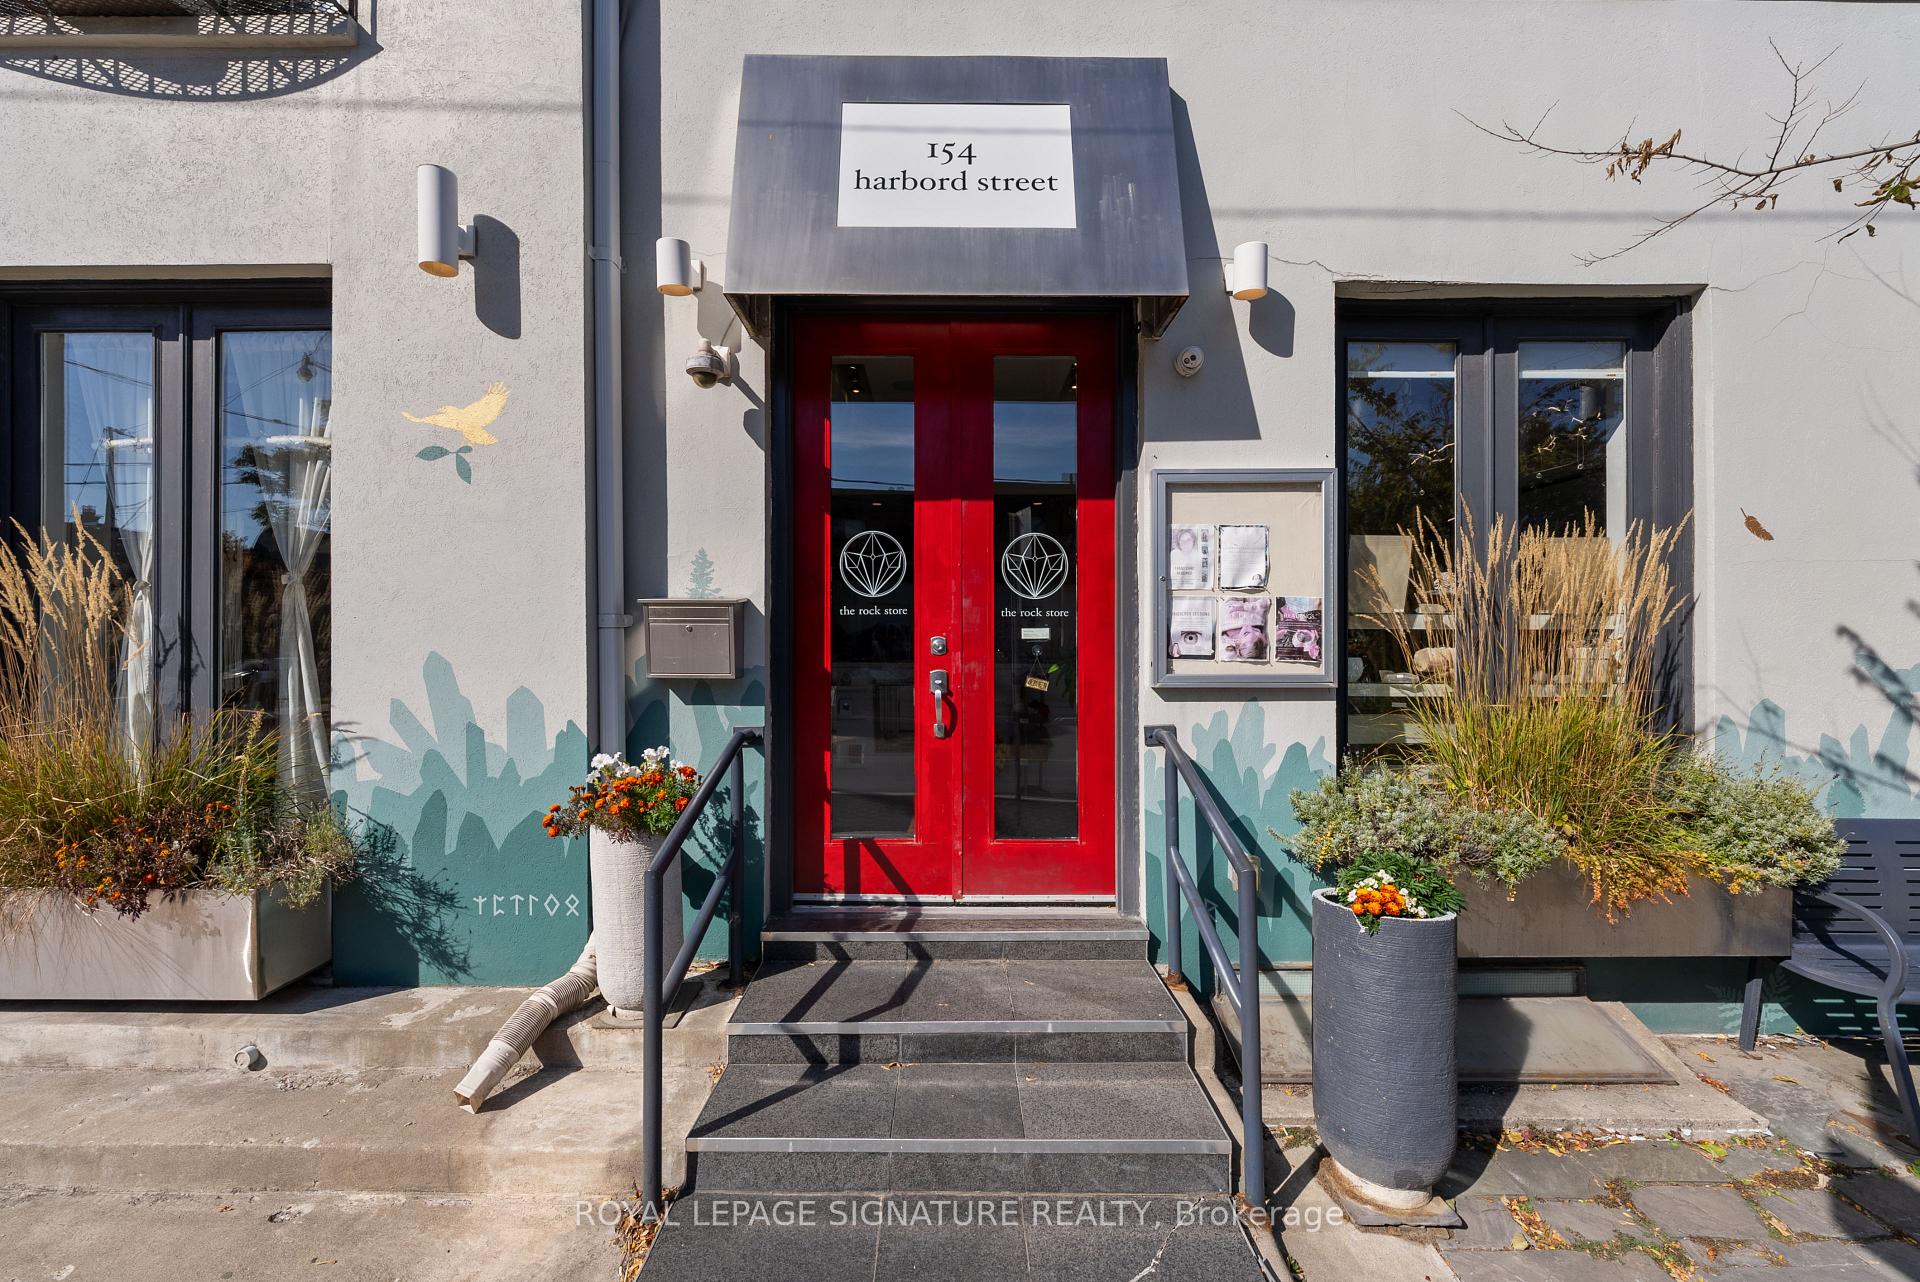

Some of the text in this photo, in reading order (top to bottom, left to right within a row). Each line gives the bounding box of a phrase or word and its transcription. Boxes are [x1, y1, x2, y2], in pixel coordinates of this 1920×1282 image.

[927, 142, 977, 165] 154
[853, 169, 1059, 192] harbord street
[839, 605, 908, 616] the rock store
[1001, 607, 1069, 617] the rock store
